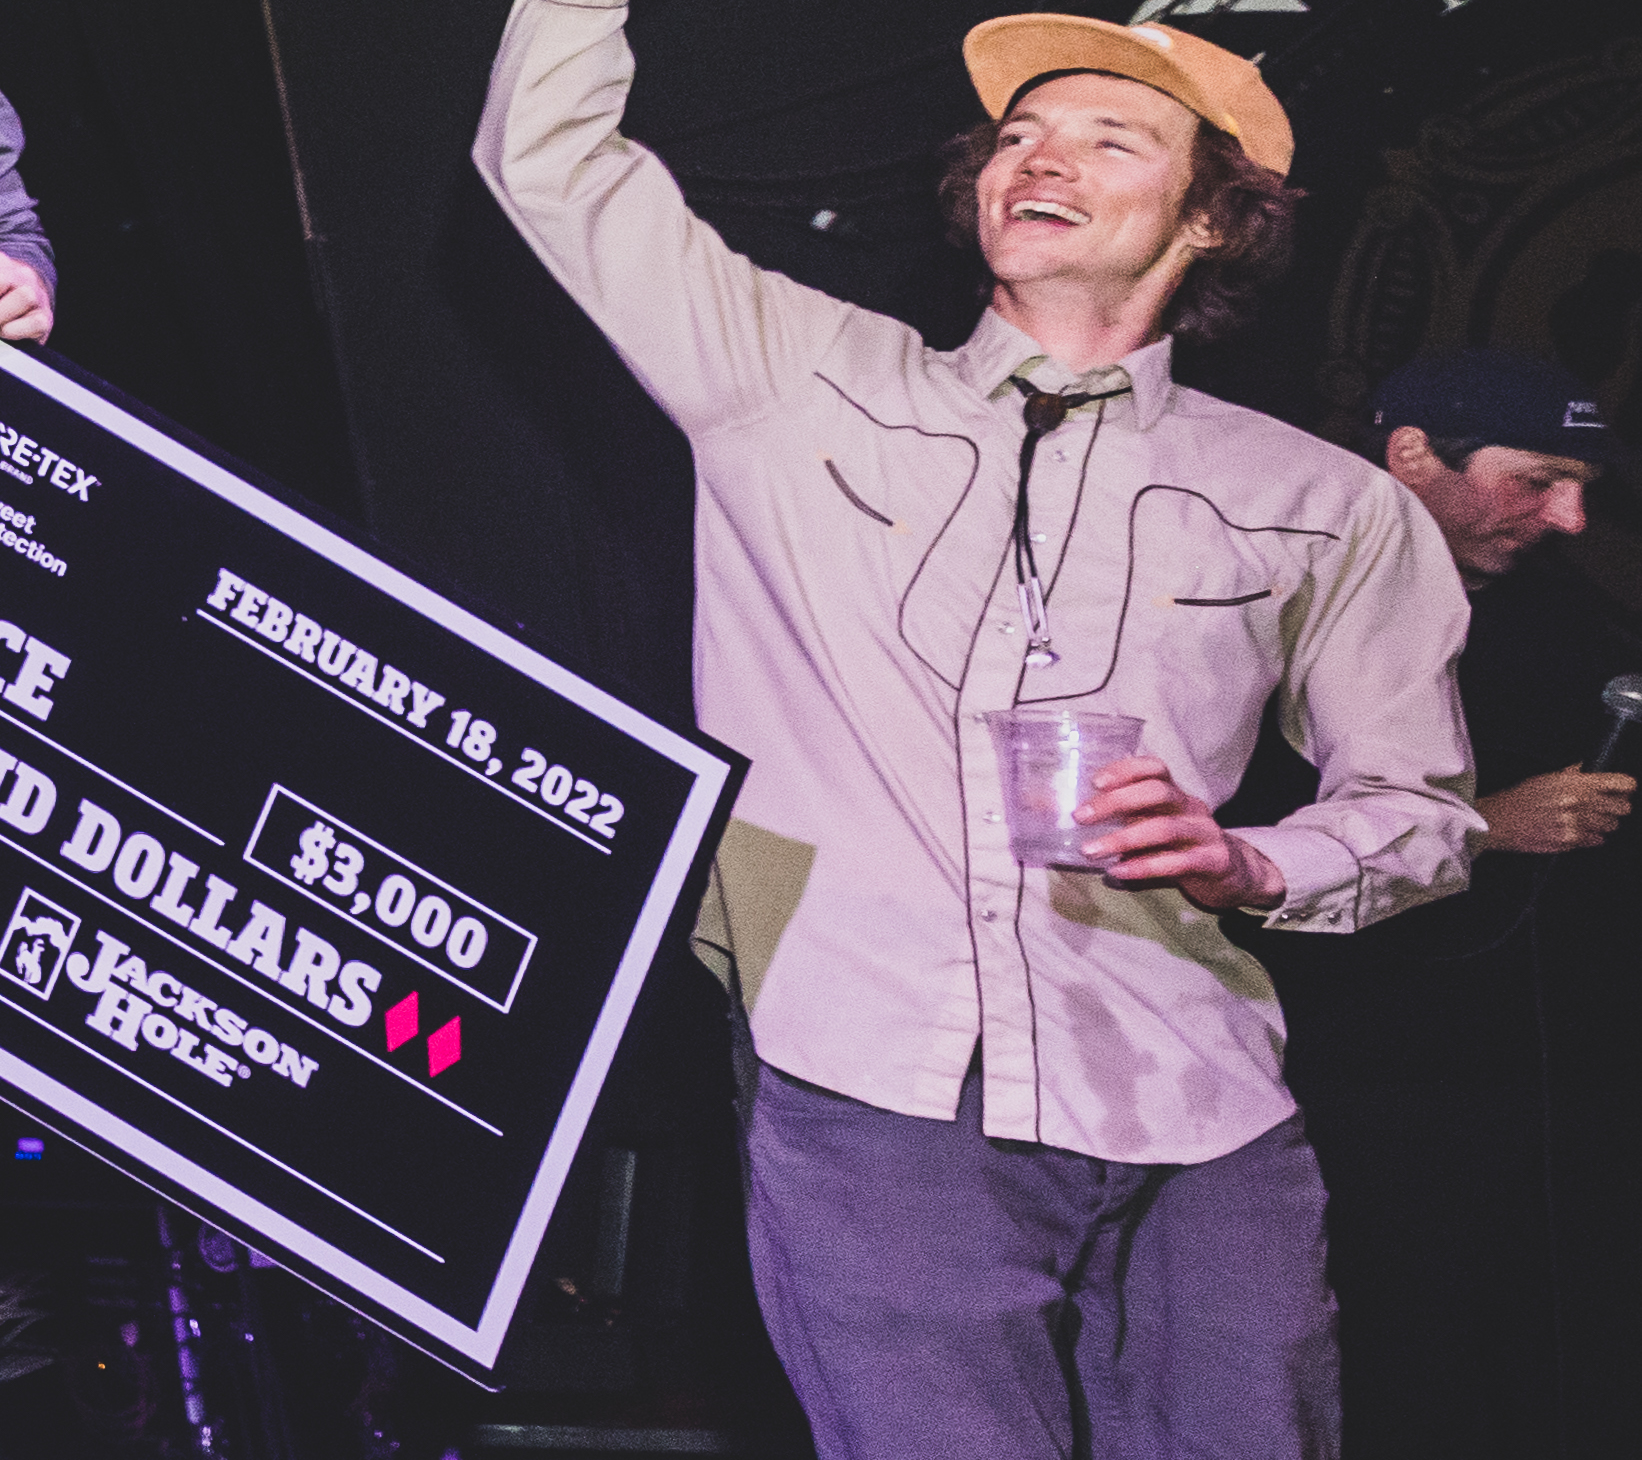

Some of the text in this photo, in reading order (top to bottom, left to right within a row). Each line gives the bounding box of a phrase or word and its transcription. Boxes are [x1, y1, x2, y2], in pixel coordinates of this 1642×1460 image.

[207, 568, 624, 838] FEBRUARY 18, 2022
[60, 799, 381, 1026] DOLLARS
[291, 822, 487, 968] $3,000
[67, 931, 319, 1087] JACKSON
